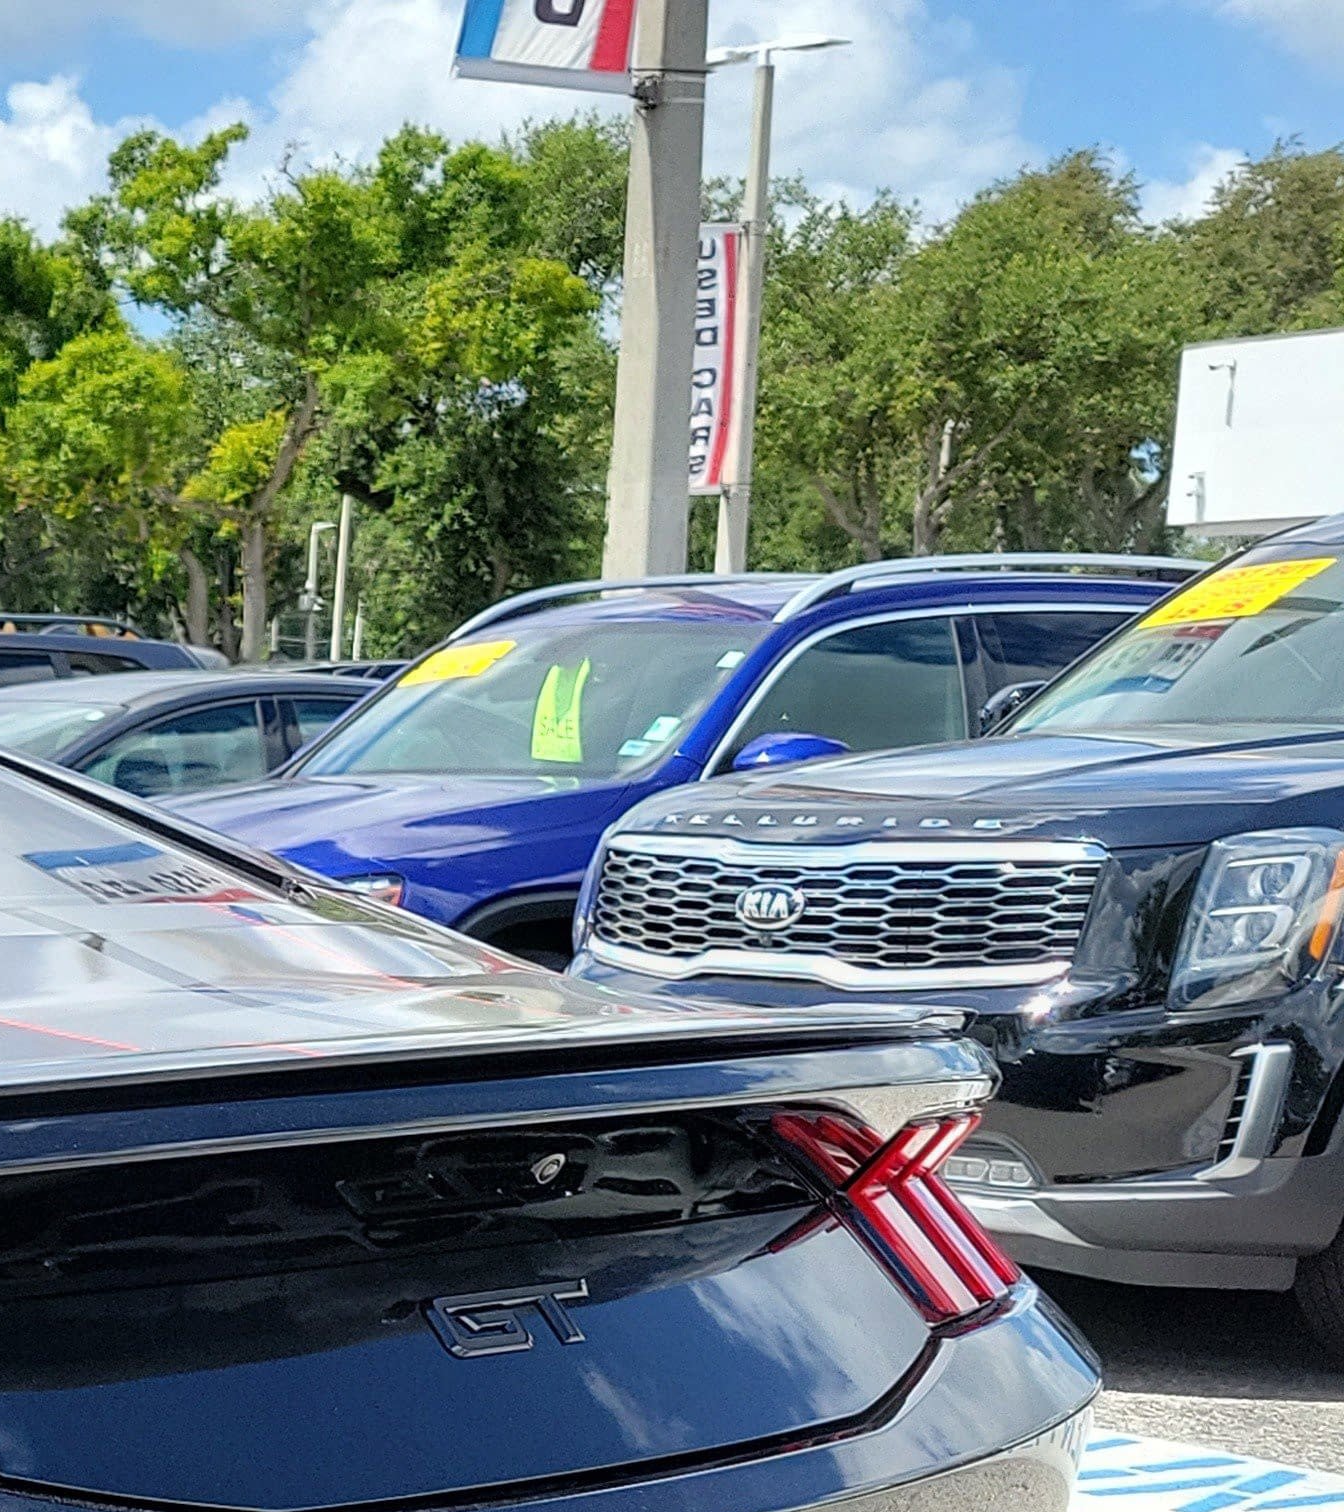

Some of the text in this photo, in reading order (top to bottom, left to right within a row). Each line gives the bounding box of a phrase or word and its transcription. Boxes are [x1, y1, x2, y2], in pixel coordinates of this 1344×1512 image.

[664, 813, 1005, 830] TELLURIDE
[743, 891, 790, 918] KIA
[425, 1278, 591, 1360] GT
